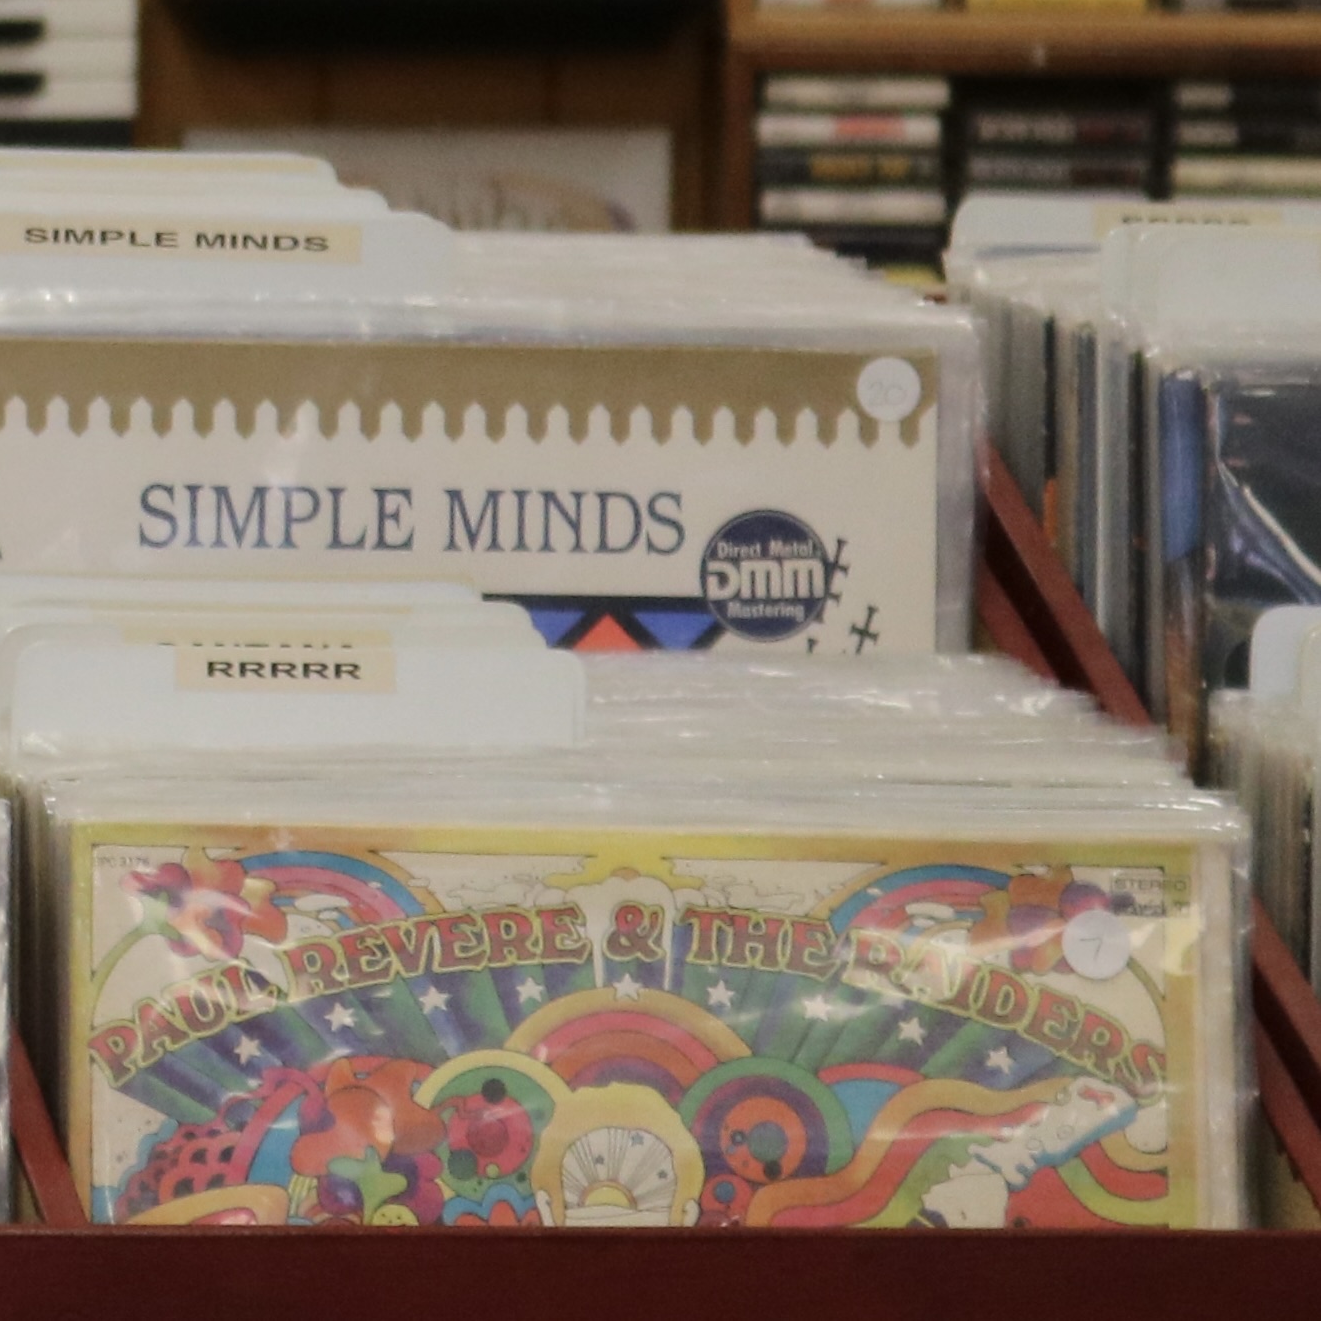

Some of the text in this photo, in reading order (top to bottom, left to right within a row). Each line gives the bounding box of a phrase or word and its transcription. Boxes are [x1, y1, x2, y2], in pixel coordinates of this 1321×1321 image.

[24, 227, 330, 252] SIMPLE MINDS
[138, 484, 686, 556] SIMPLE MINDS
[717, 537, 813, 559] Direct Metal
[726, 601, 805, 623] Mastering
[206, 660, 361, 680] RRRRR
[87, 899, 1168, 1103] PAUL REVERE & THE RAIDERS
